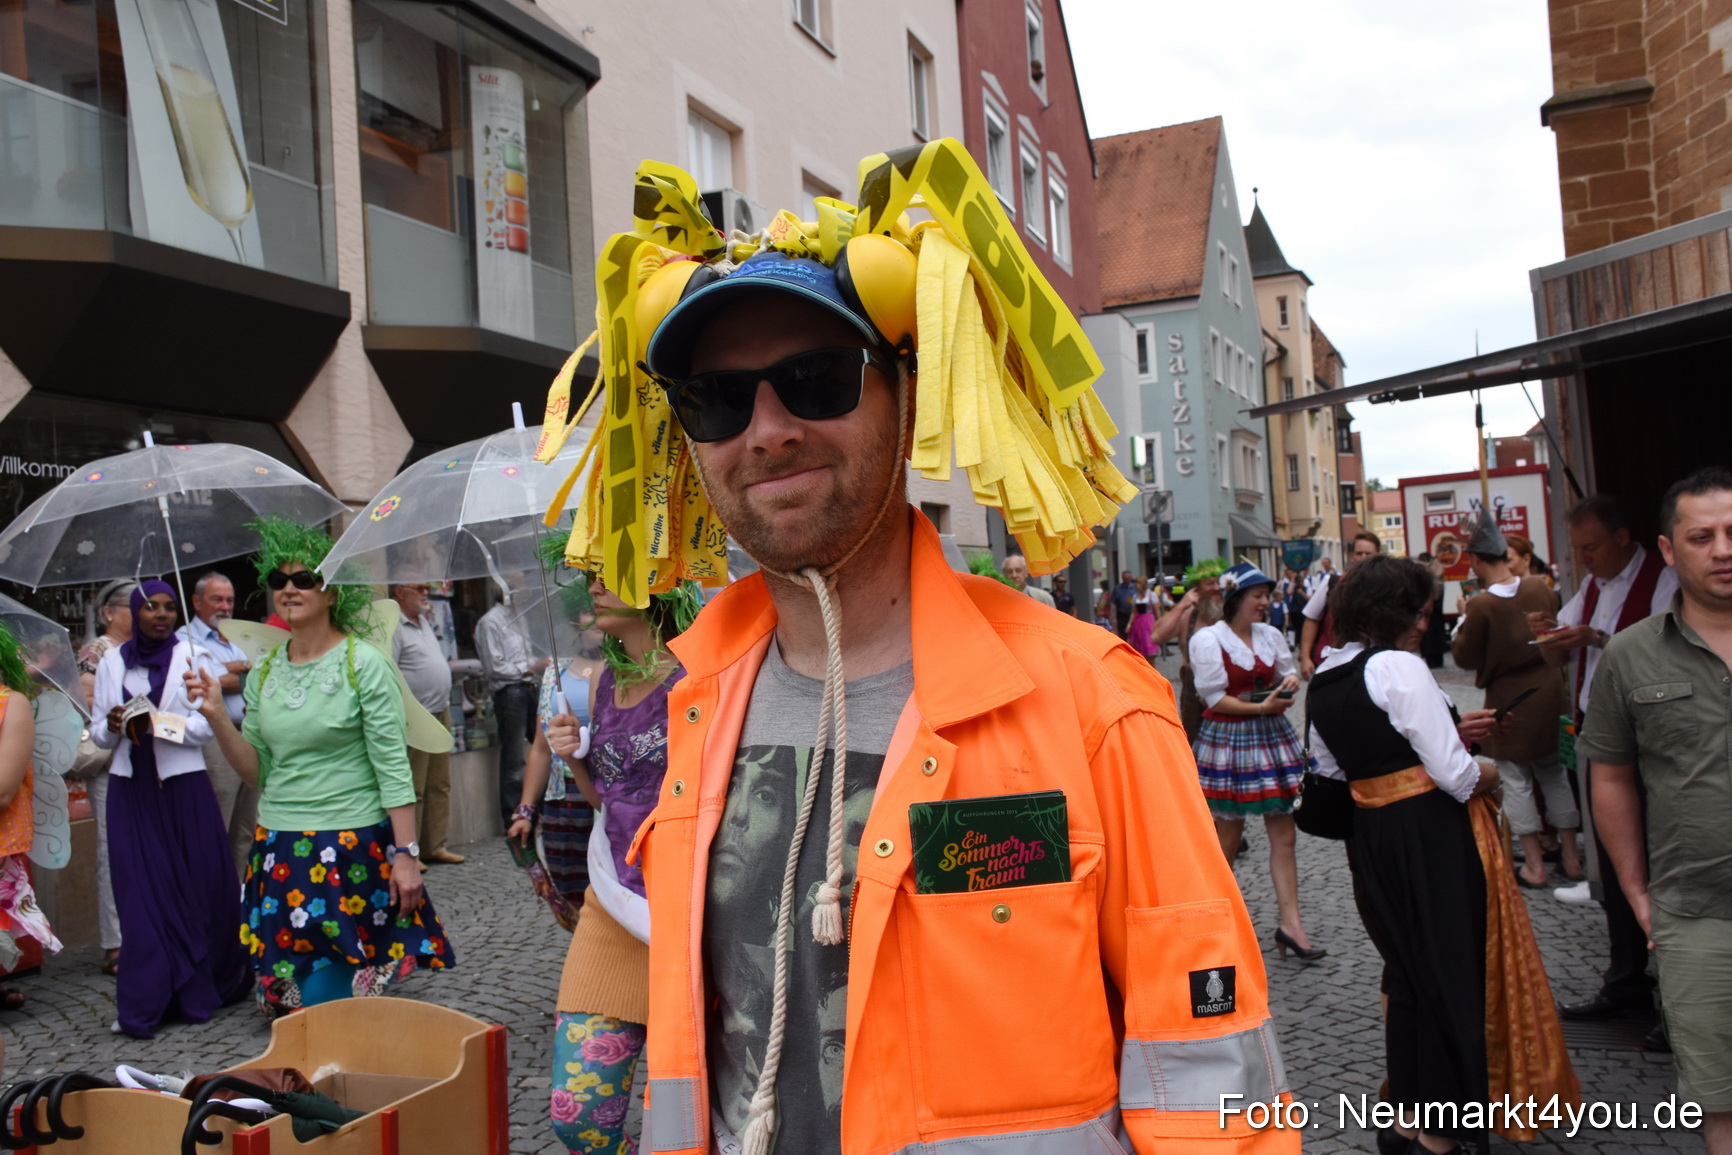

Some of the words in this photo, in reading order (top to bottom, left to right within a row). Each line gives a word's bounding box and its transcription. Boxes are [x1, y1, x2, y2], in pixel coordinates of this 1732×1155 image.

[1168, 332, 1193, 475] satzke
[650, 514, 664, 555] Microfibre
[938, 835, 1019, 872] Sommer
[961, 830, 988, 849] Ein
[987, 840, 1047, 873] nachts
[1197, 1002, 1232, 1013] MASCOT
